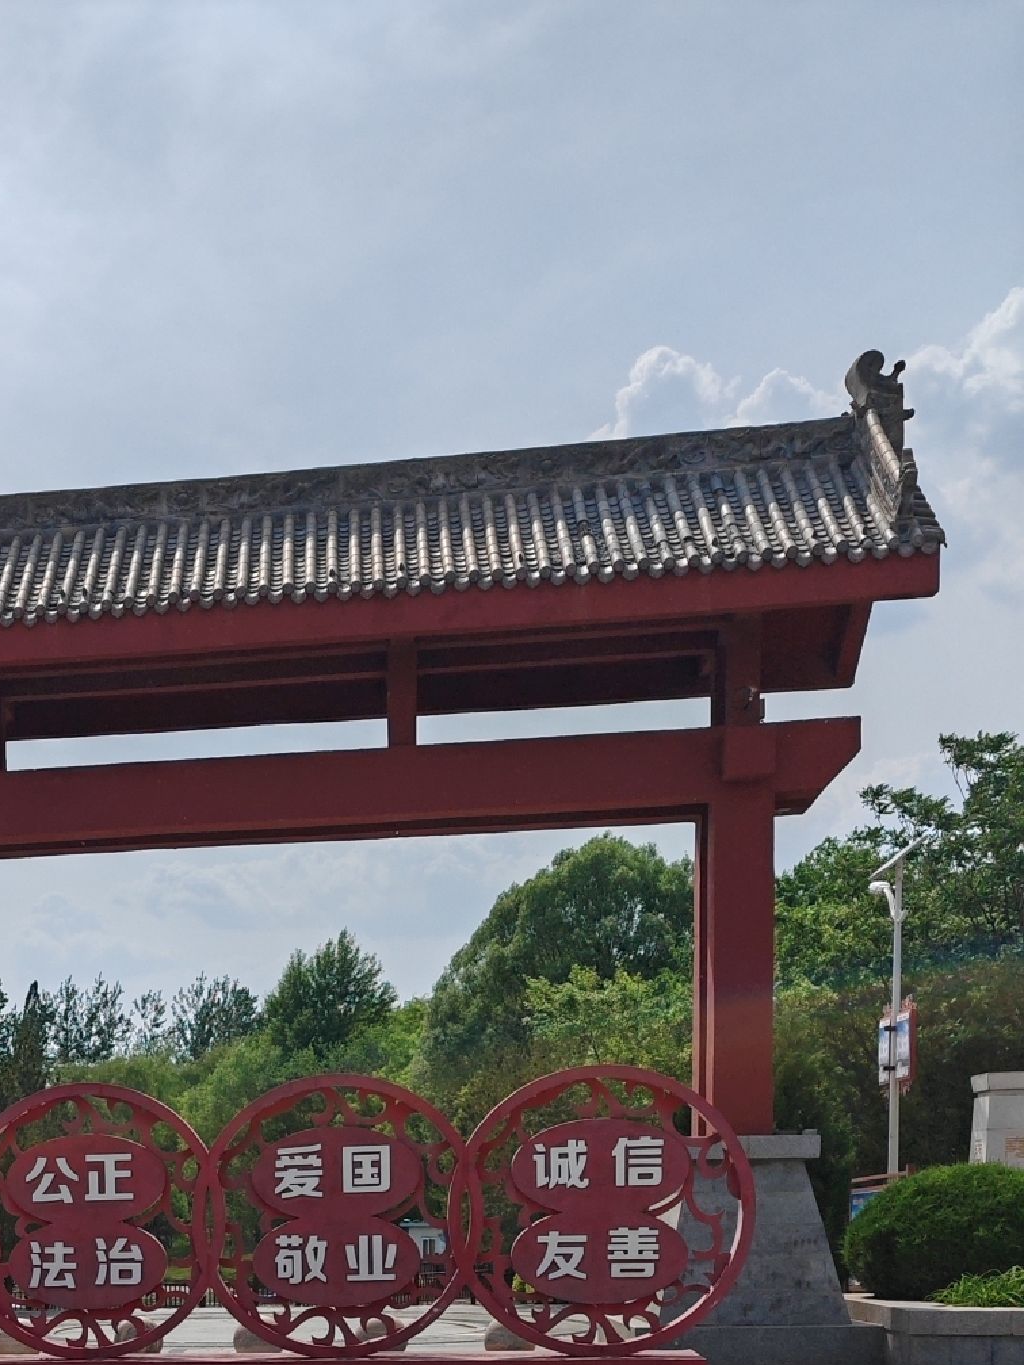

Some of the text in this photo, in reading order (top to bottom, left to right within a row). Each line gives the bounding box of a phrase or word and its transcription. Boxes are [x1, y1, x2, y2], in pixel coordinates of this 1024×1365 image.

[26, 1154, 133, 1203] 公正
[275, 1144, 390, 1198] 爱国
[534, 1136, 664, 1189] 诚信
[30, 1239, 142, 1288] 法治
[275, 1235, 396, 1284] 敬业
[536, 1227, 658, 1280] 友善
